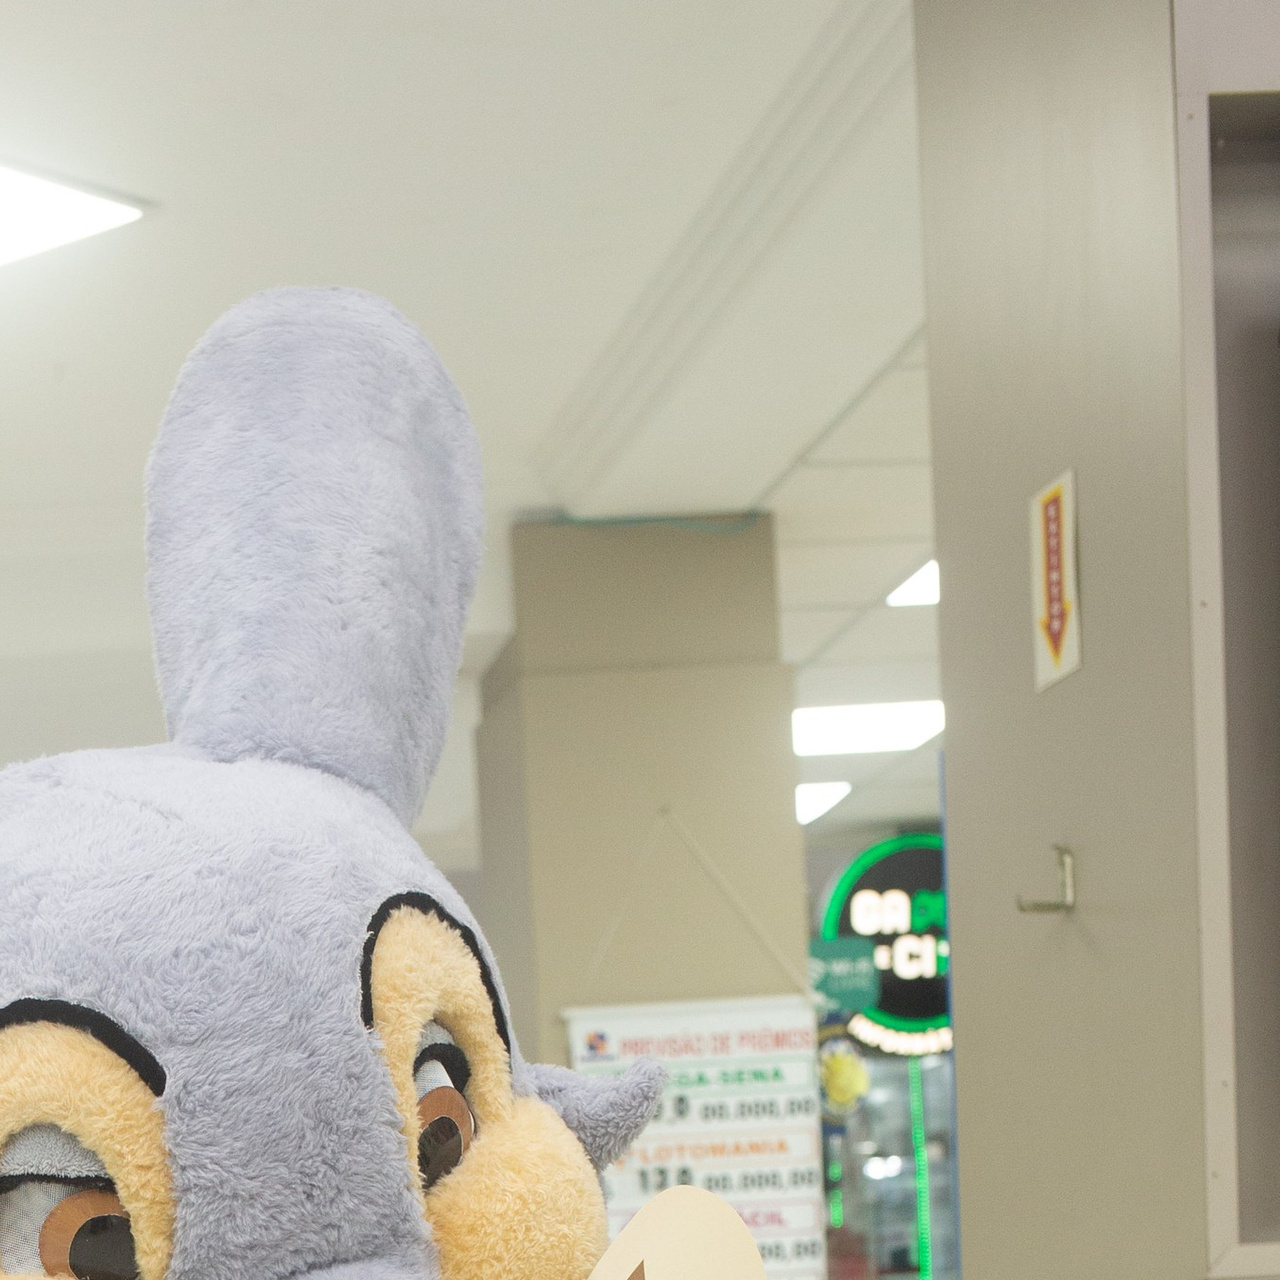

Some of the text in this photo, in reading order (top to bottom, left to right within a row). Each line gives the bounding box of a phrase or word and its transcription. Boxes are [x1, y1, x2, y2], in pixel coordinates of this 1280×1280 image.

[621, 1027, 814, 1057] PREVISÃO DE PRÊMIOS
[639, 1137, 789, 1164] LOTOMANIA
